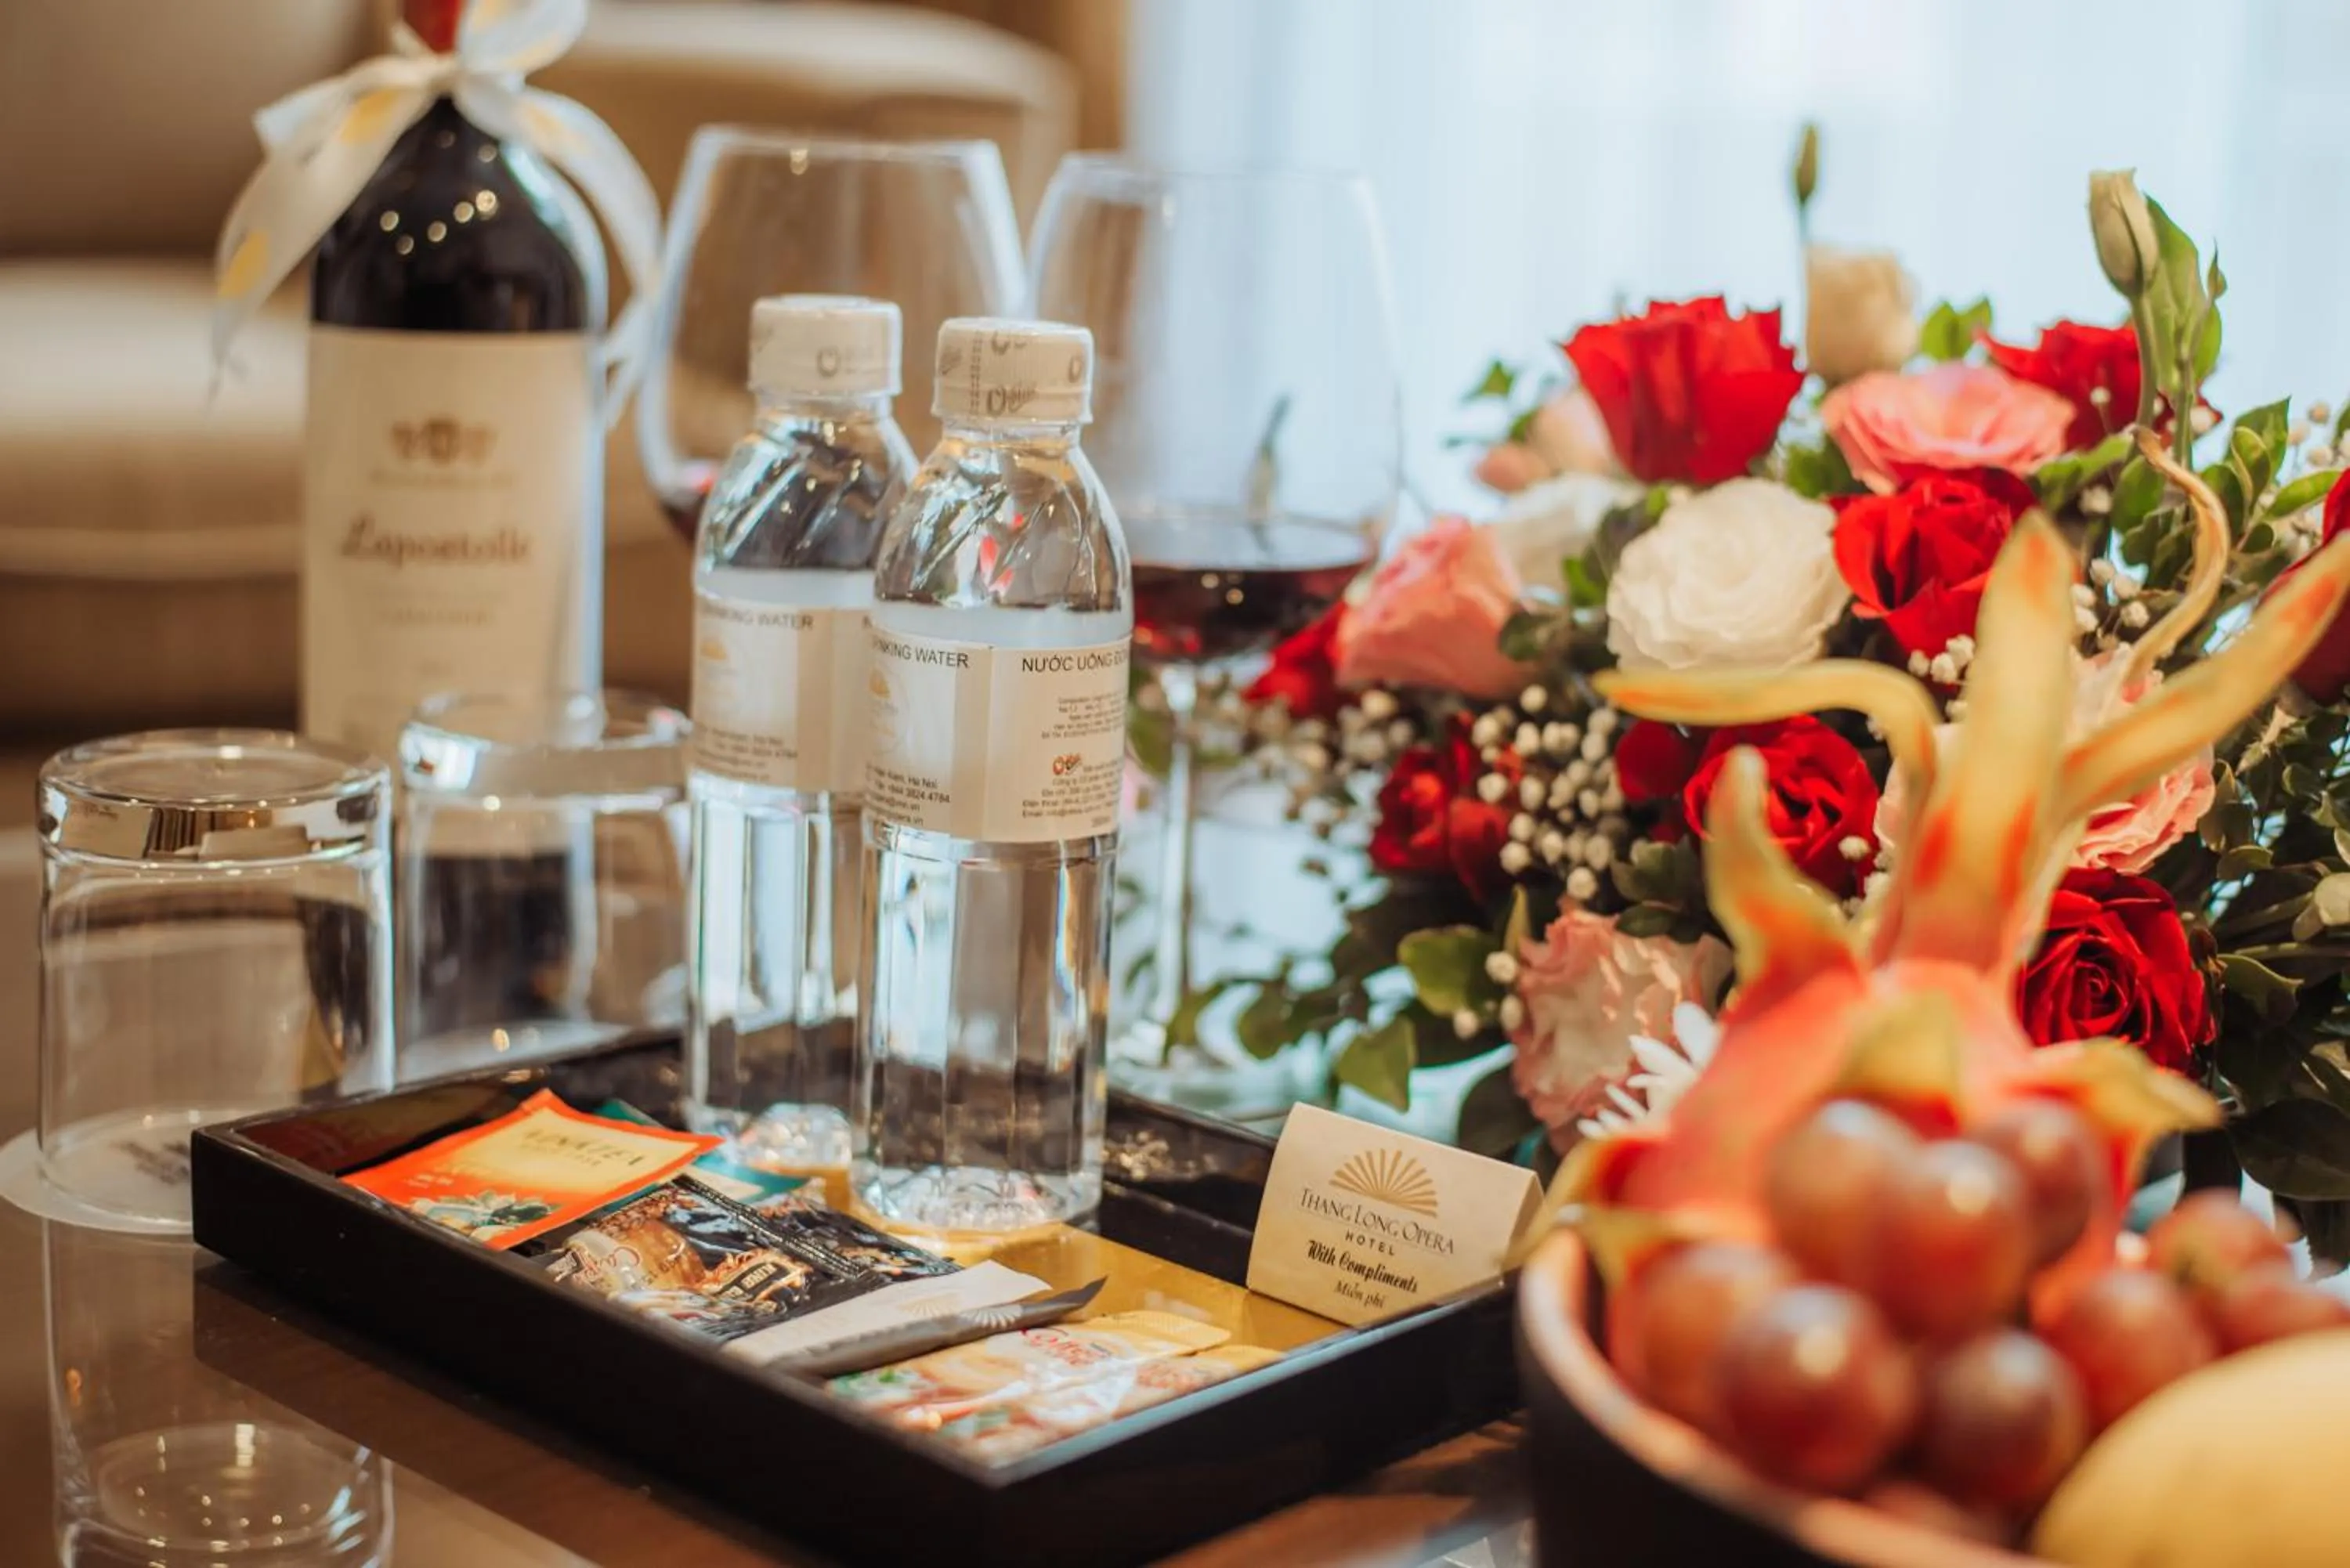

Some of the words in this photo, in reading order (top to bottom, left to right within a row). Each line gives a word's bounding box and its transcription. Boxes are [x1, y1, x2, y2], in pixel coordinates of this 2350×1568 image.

[915, 645, 969, 668] WATER
[1301, 1187, 1353, 1222] THANG
[1354, 1204, 1399, 1237] LONG
[1402, 1221, 1455, 1255] OPERA
[1345, 1229, 1394, 1256] HOTEL
[1307, 1240, 1336, 1266] With
[1339, 1251, 1418, 1294] Compliments
